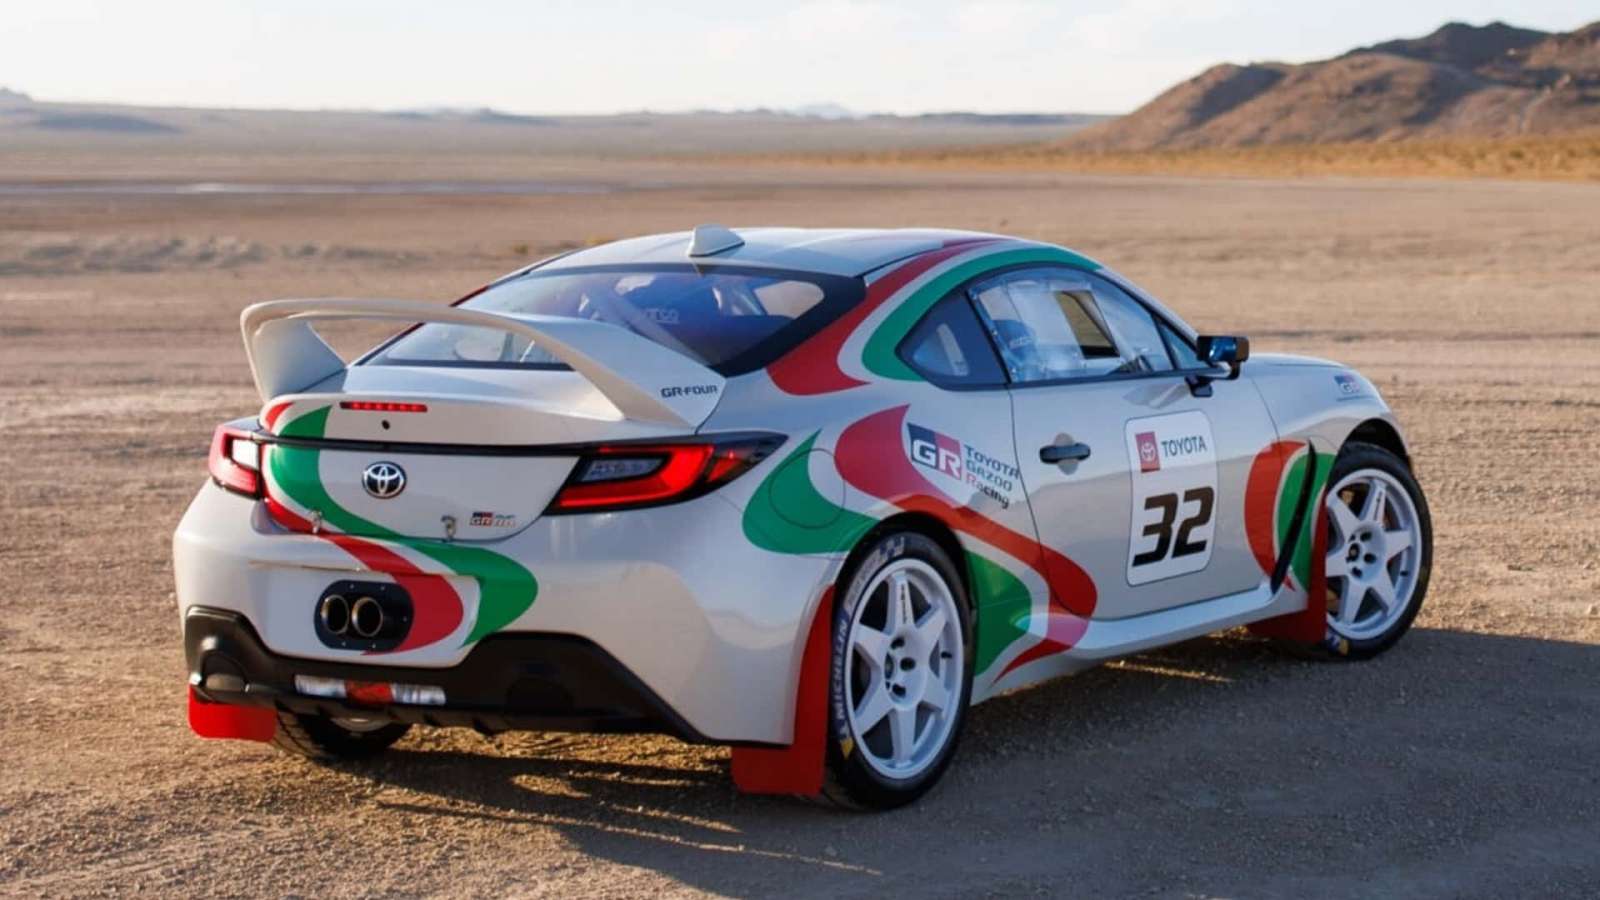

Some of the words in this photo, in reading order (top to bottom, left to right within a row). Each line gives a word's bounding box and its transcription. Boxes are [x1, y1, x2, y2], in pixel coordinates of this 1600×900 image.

[912, 438, 961, 480] GR
[964, 443, 1019, 480] TOYOTA
[1161, 435, 1207, 457] TOYOTA
[966, 460, 1012, 492] GAZOO
[966, 472, 1009, 510] Racing
[1132, 486, 1214, 567] 32
[832, 620, 849, 720] MICHELIN
